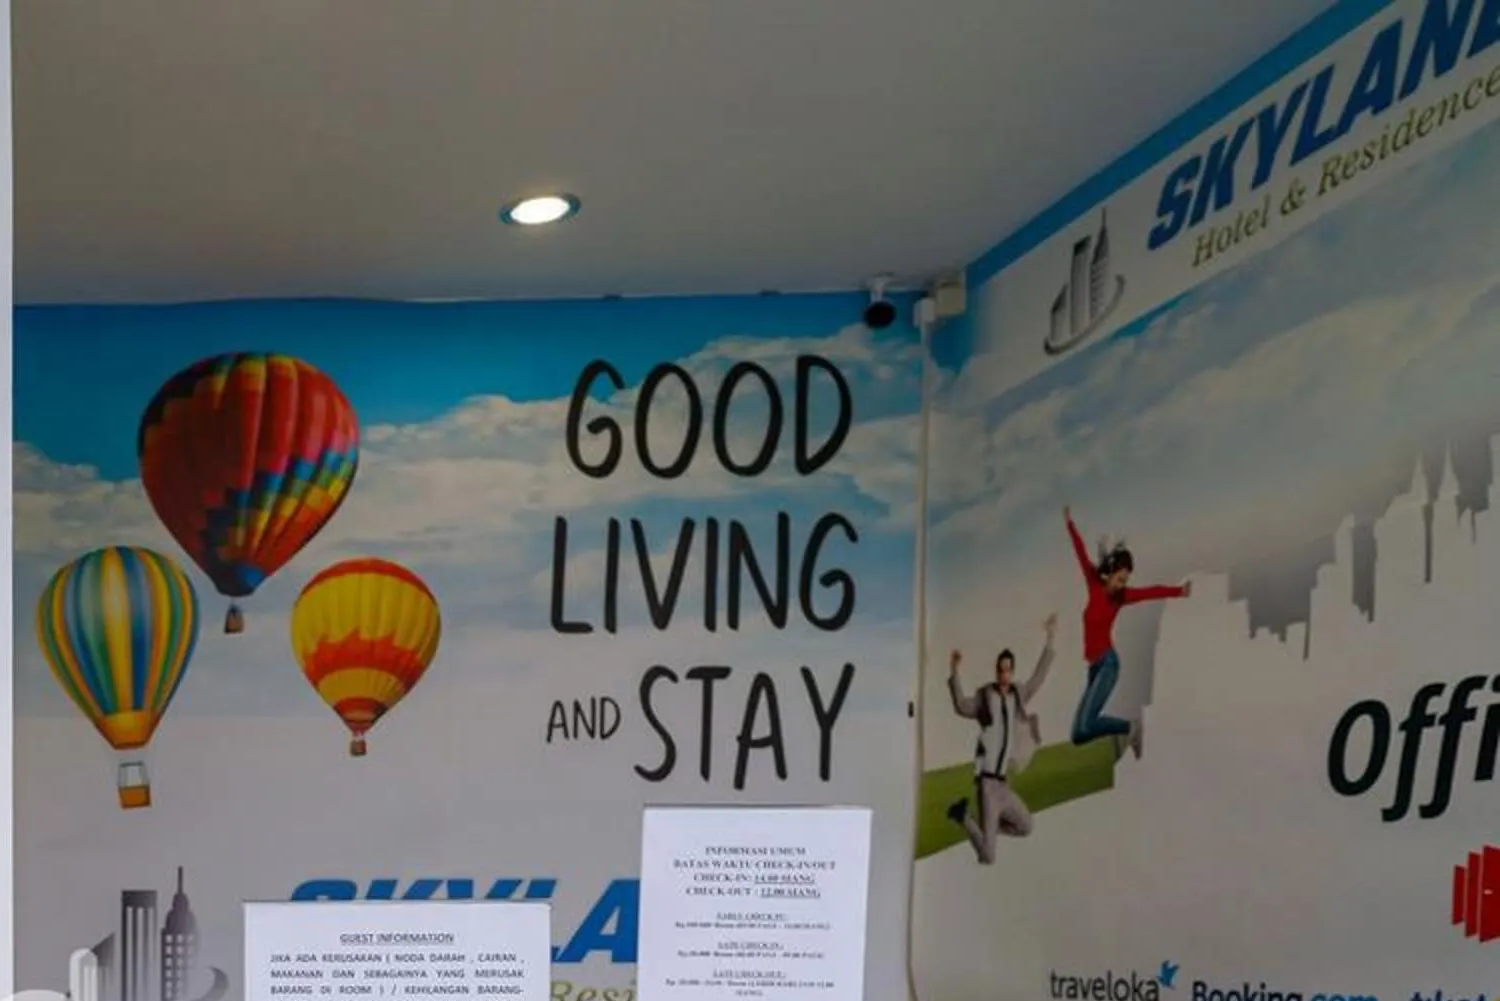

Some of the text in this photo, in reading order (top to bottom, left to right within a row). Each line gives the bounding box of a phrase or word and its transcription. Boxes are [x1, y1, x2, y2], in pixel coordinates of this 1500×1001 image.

[1192, 66, 1500, 268] Hotel & Residence
[566, 354, 852, 479] GOOD
[550, 511, 859, 634] LIVING
[546, 662, 855, 790] AND STAY
[270, 953, 291, 963] JIKA
[296, 953, 318, 963] ADA
[322, 953, 382, 963] KERUSAKAN
[394, 953, 425, 963] NODA
[429, 953, 466, 963] DARAH
[478, 953, 516, 963] CAIRAN
[339, 933, 454, 945] GUEST INFORMATION
[270, 969, 525, 979] MAKANAN DAN SEBAGAINYA YANG MERUSAK
[270, 985, 312, 995] BARANG
[320, 985, 332, 995] DI
[339, 985, 372, 995] ROOM
[404, 985, 469, 995] KEHILANGAN
